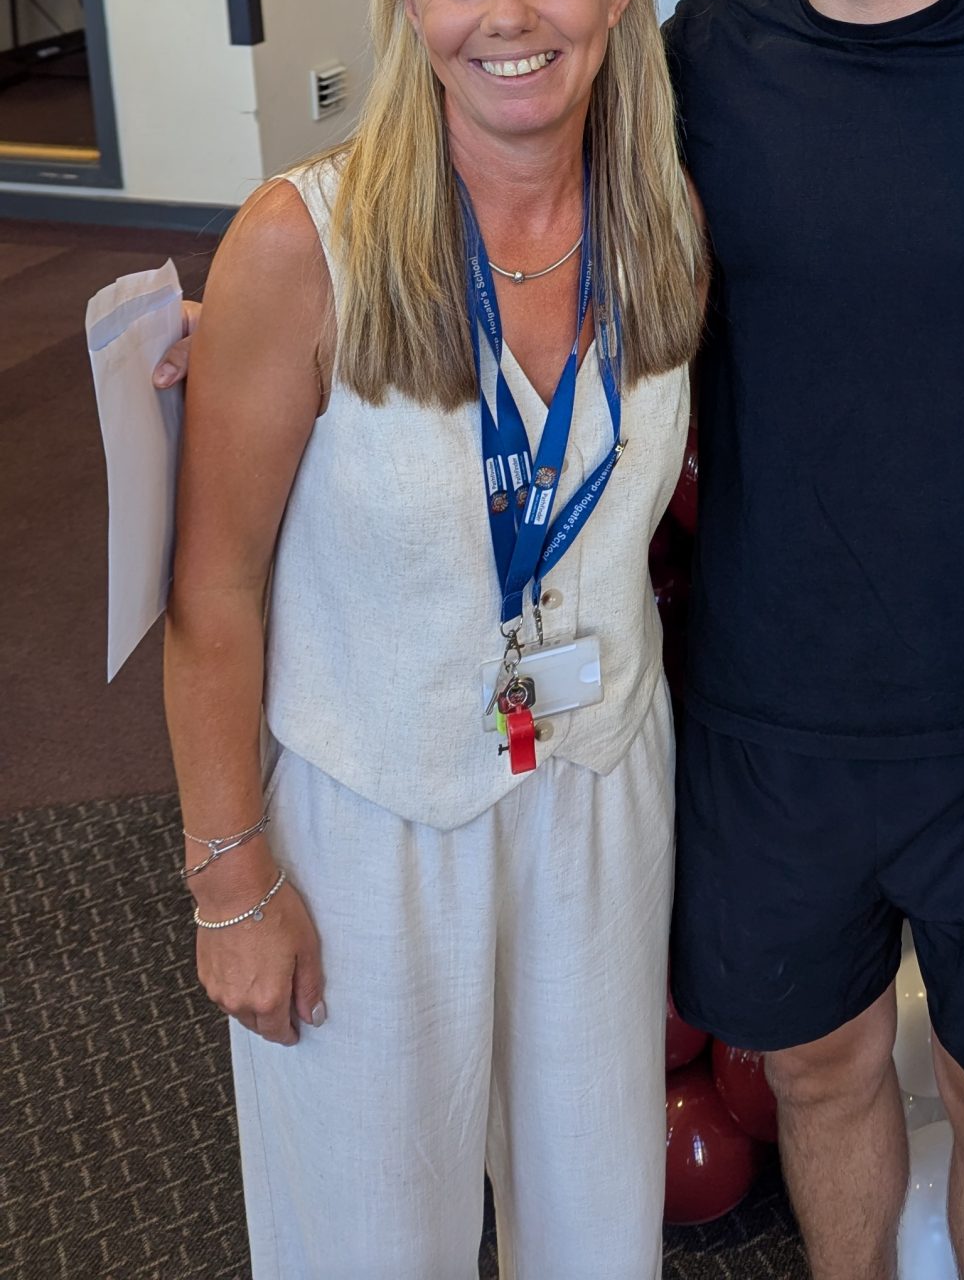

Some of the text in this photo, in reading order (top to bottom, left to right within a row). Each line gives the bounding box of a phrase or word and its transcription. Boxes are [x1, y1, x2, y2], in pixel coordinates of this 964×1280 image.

[469, 256, 485, 289] School
[480, 291, 497, 335] Holgate's
[567, 492, 594, 528] Holgate's
[543, 531, 567, 562] School
